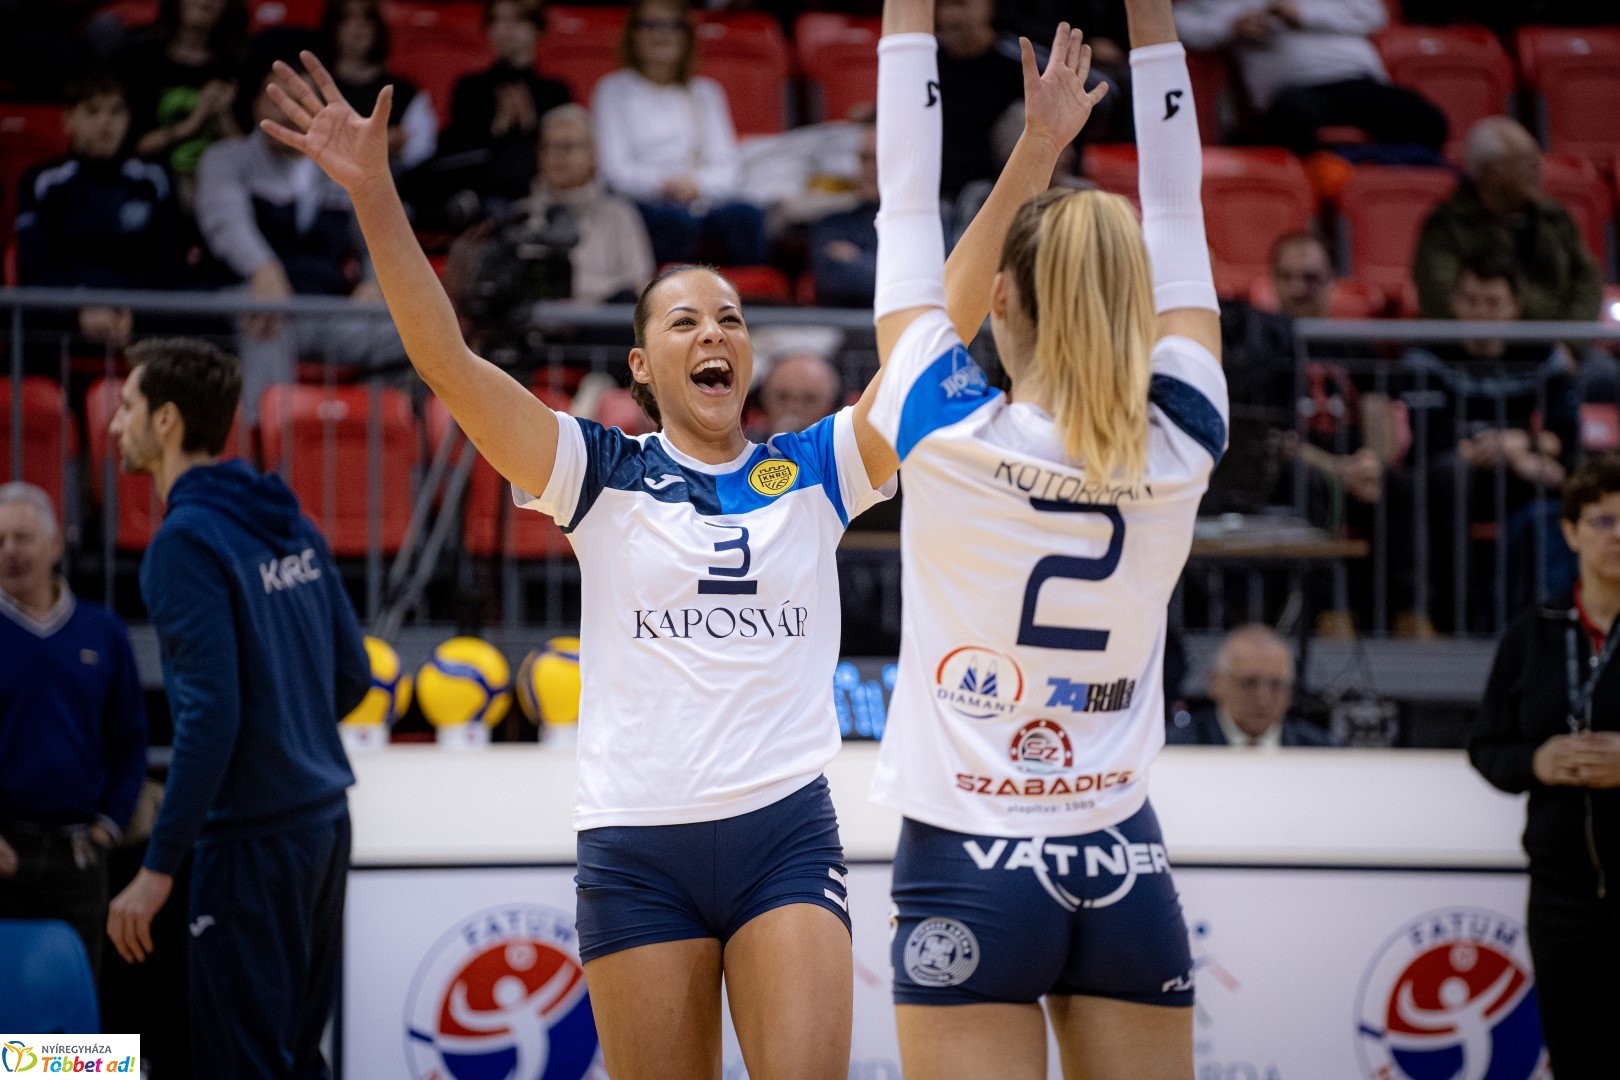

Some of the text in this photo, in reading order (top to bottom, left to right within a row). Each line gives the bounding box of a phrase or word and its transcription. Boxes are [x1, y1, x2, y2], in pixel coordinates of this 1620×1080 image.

[704, 521, 751, 578] 3
[1016, 496, 1126, 652] 2
[633, 599, 808, 639] KAPOSVÁR
[936, 688, 1017, 714] DIAMANT
[956, 770, 1133, 796] SZABADICS
[1408, 911, 1520, 949] FATUM
